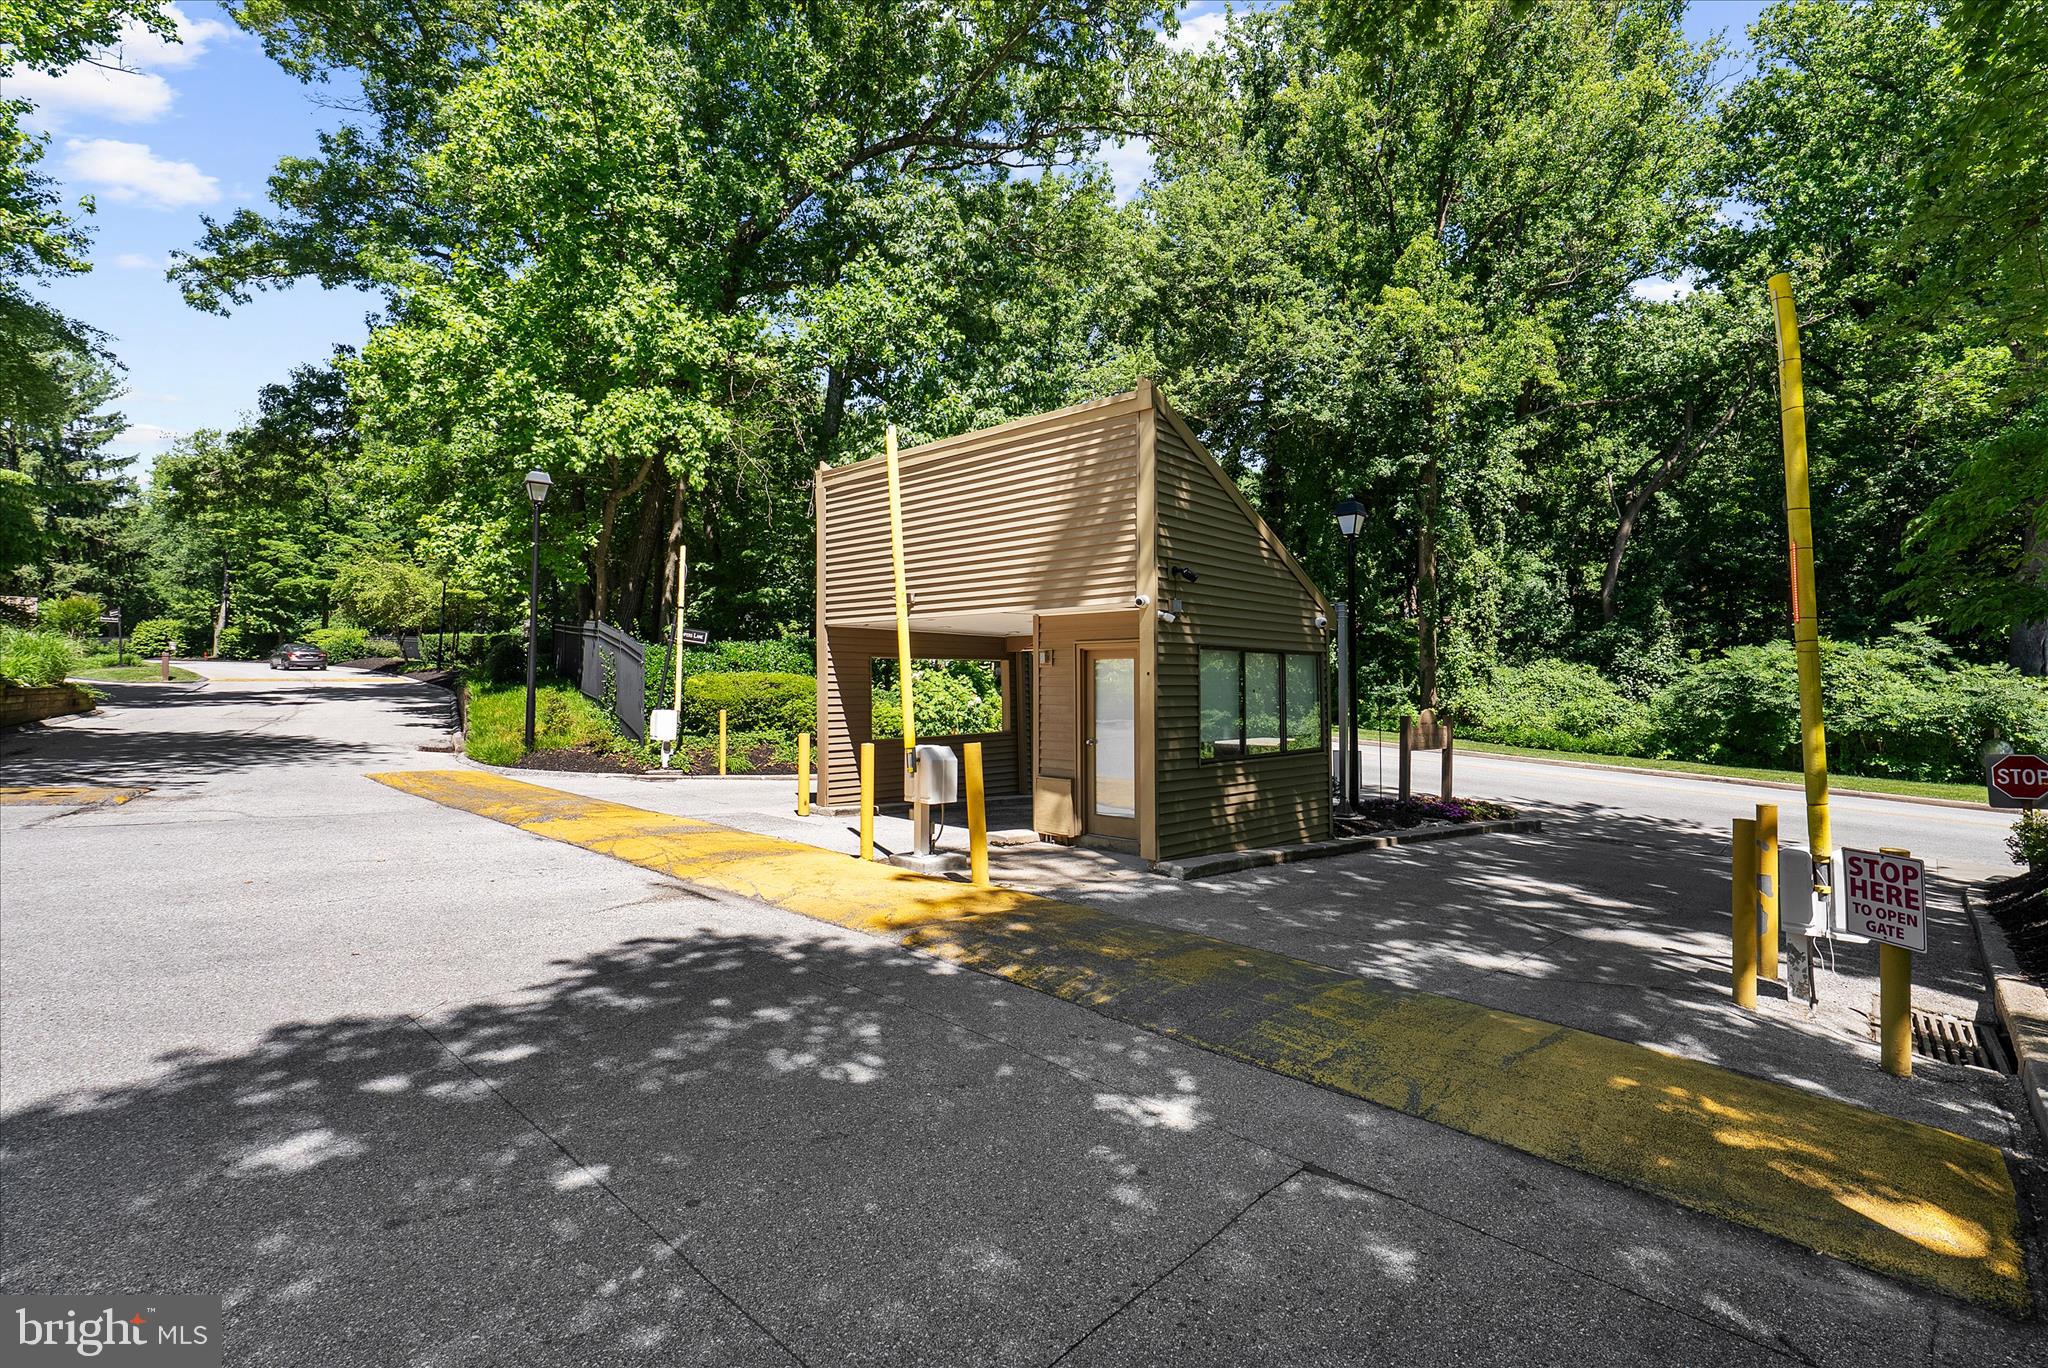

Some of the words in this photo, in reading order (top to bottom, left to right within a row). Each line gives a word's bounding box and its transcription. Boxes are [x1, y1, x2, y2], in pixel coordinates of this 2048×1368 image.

[1997, 768, 2048, 786] STOP
[1848, 856, 1919, 886] STOP
[1850, 877, 1920, 911] HERE
[1852, 901, 1872, 916] TO
[1876, 907, 1918, 928] OPEN
[1866, 920, 1905, 940] GATE
